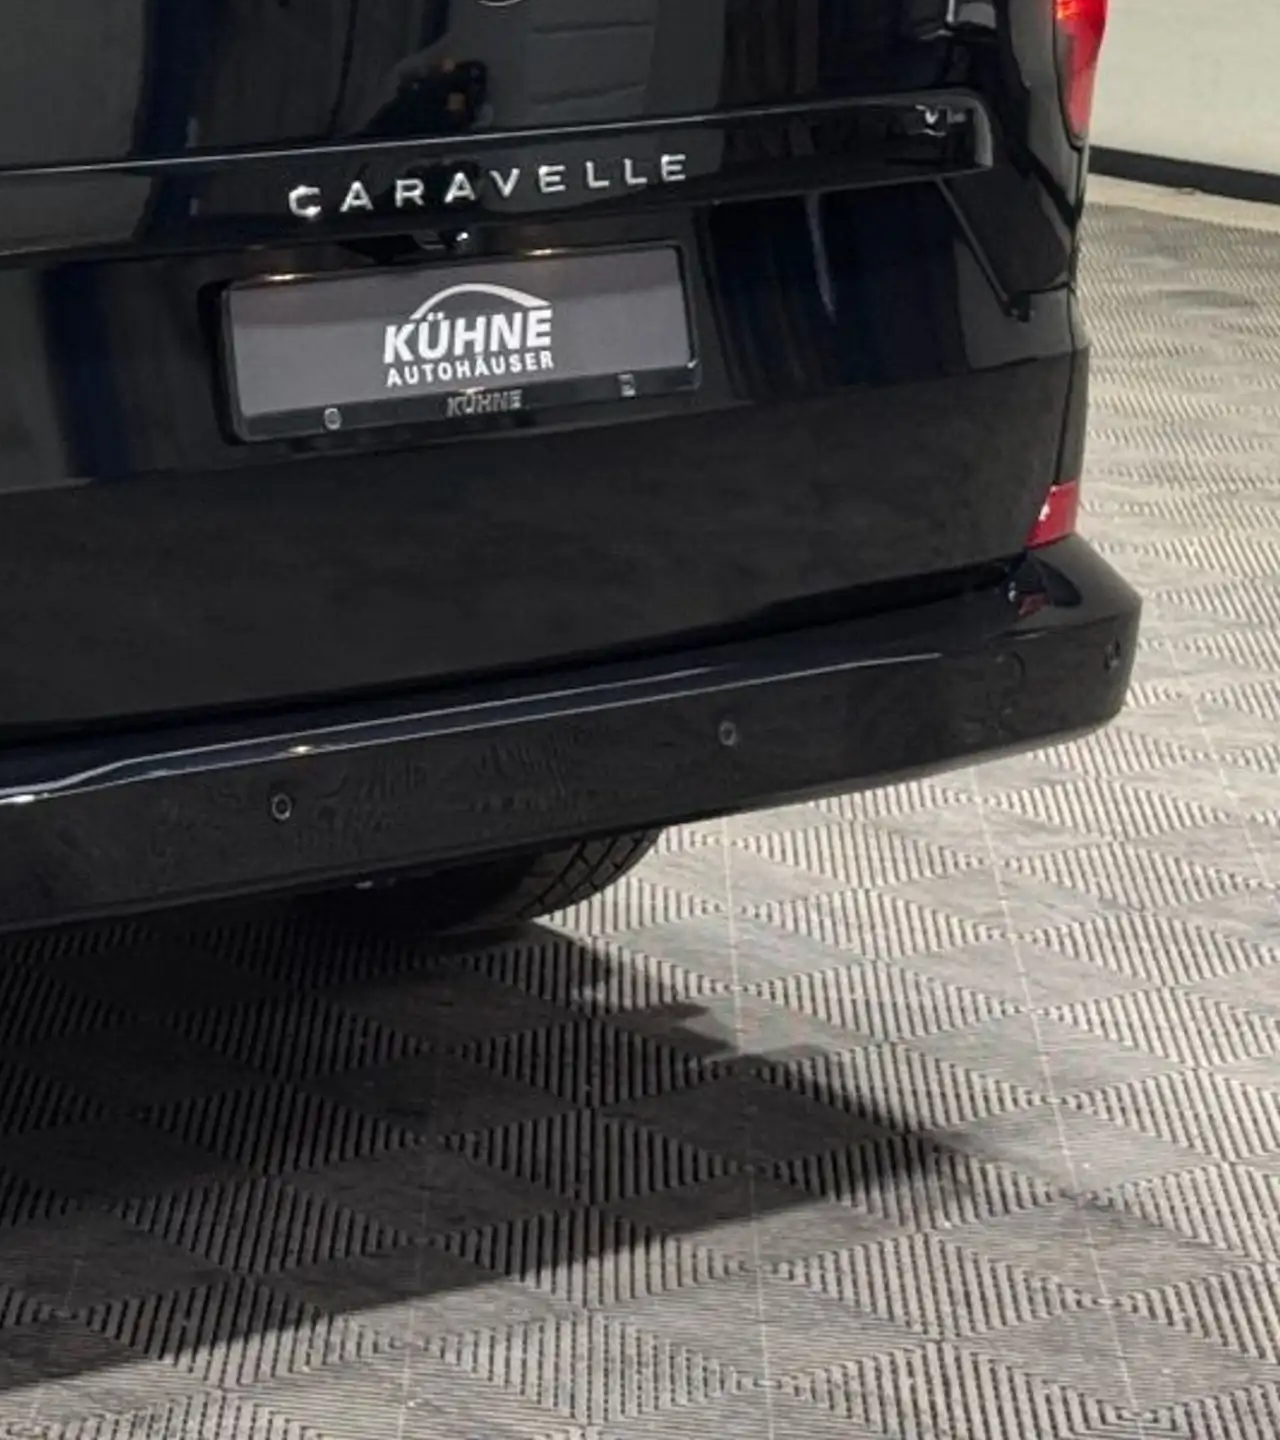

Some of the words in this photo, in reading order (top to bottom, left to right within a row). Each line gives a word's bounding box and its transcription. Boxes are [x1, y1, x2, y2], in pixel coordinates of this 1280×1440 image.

[288, 153, 687, 218] CARAVELLE
[383, 309, 553, 364] KÜHNE
[386, 350, 554, 387] AUTOHÄUSER
